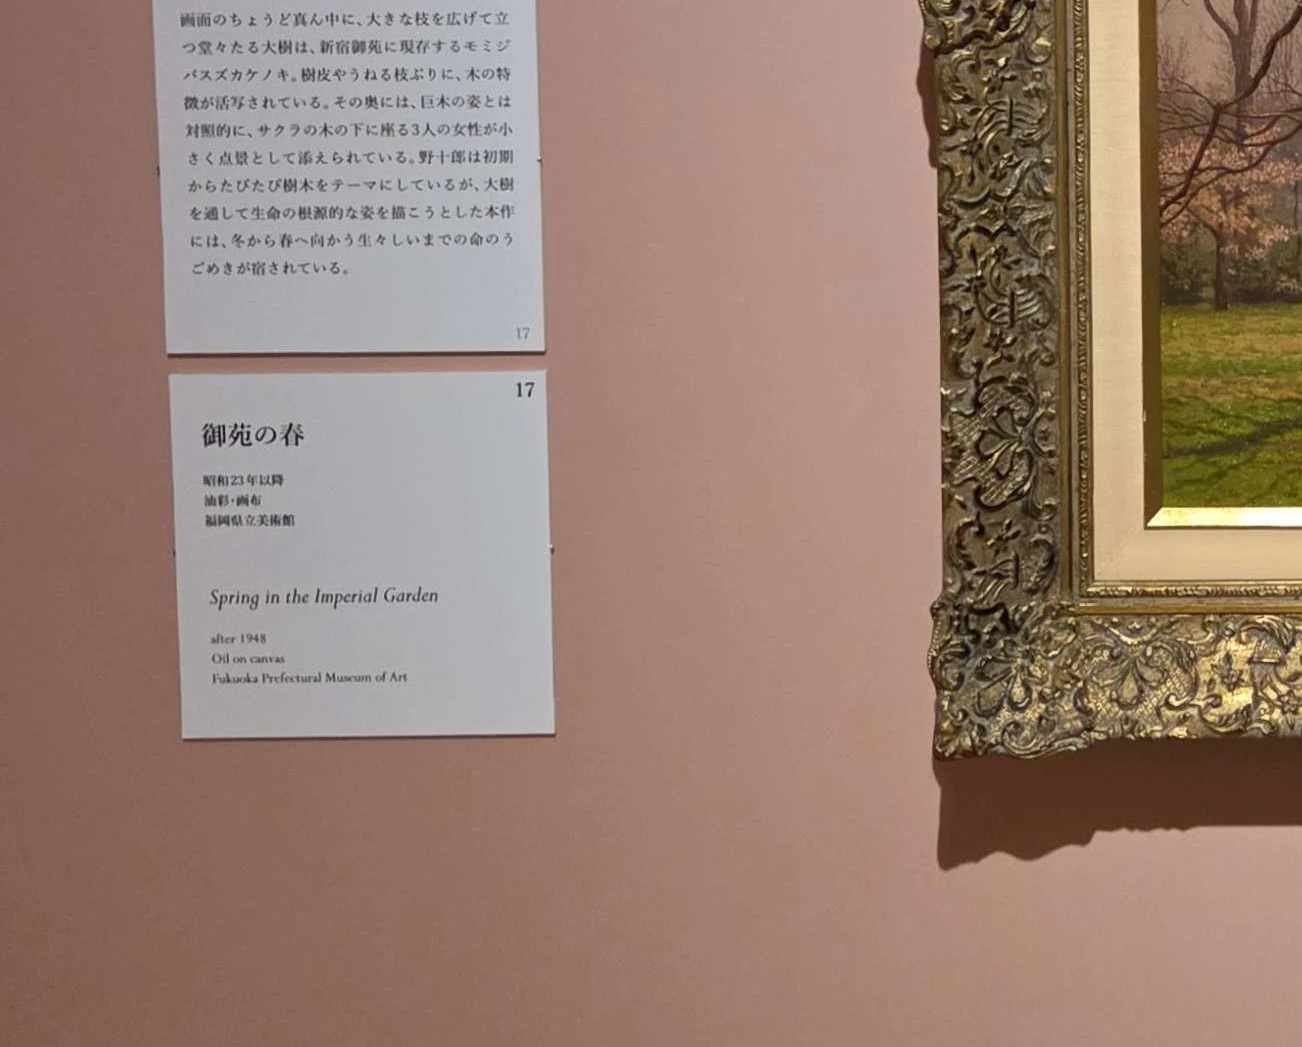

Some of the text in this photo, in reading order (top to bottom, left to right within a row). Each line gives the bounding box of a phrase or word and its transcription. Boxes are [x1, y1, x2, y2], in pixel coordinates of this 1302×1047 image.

[516, 327, 531, 340] 17
[515, 381, 536, 399] 17
[201, 421, 305, 449] 御苑の春
[202, 473, 285, 488] 昭和23年以降
[204, 513, 296, 528] 福岡県立美術館
[208, 585, 439, 612] Spring in the Imperial Garden
[210, 632, 267, 645] after 1948
[211, 652, 286, 665] Oil on canvas
[212, 670, 408, 685] Fukuoka Prefectural Museum of Art
